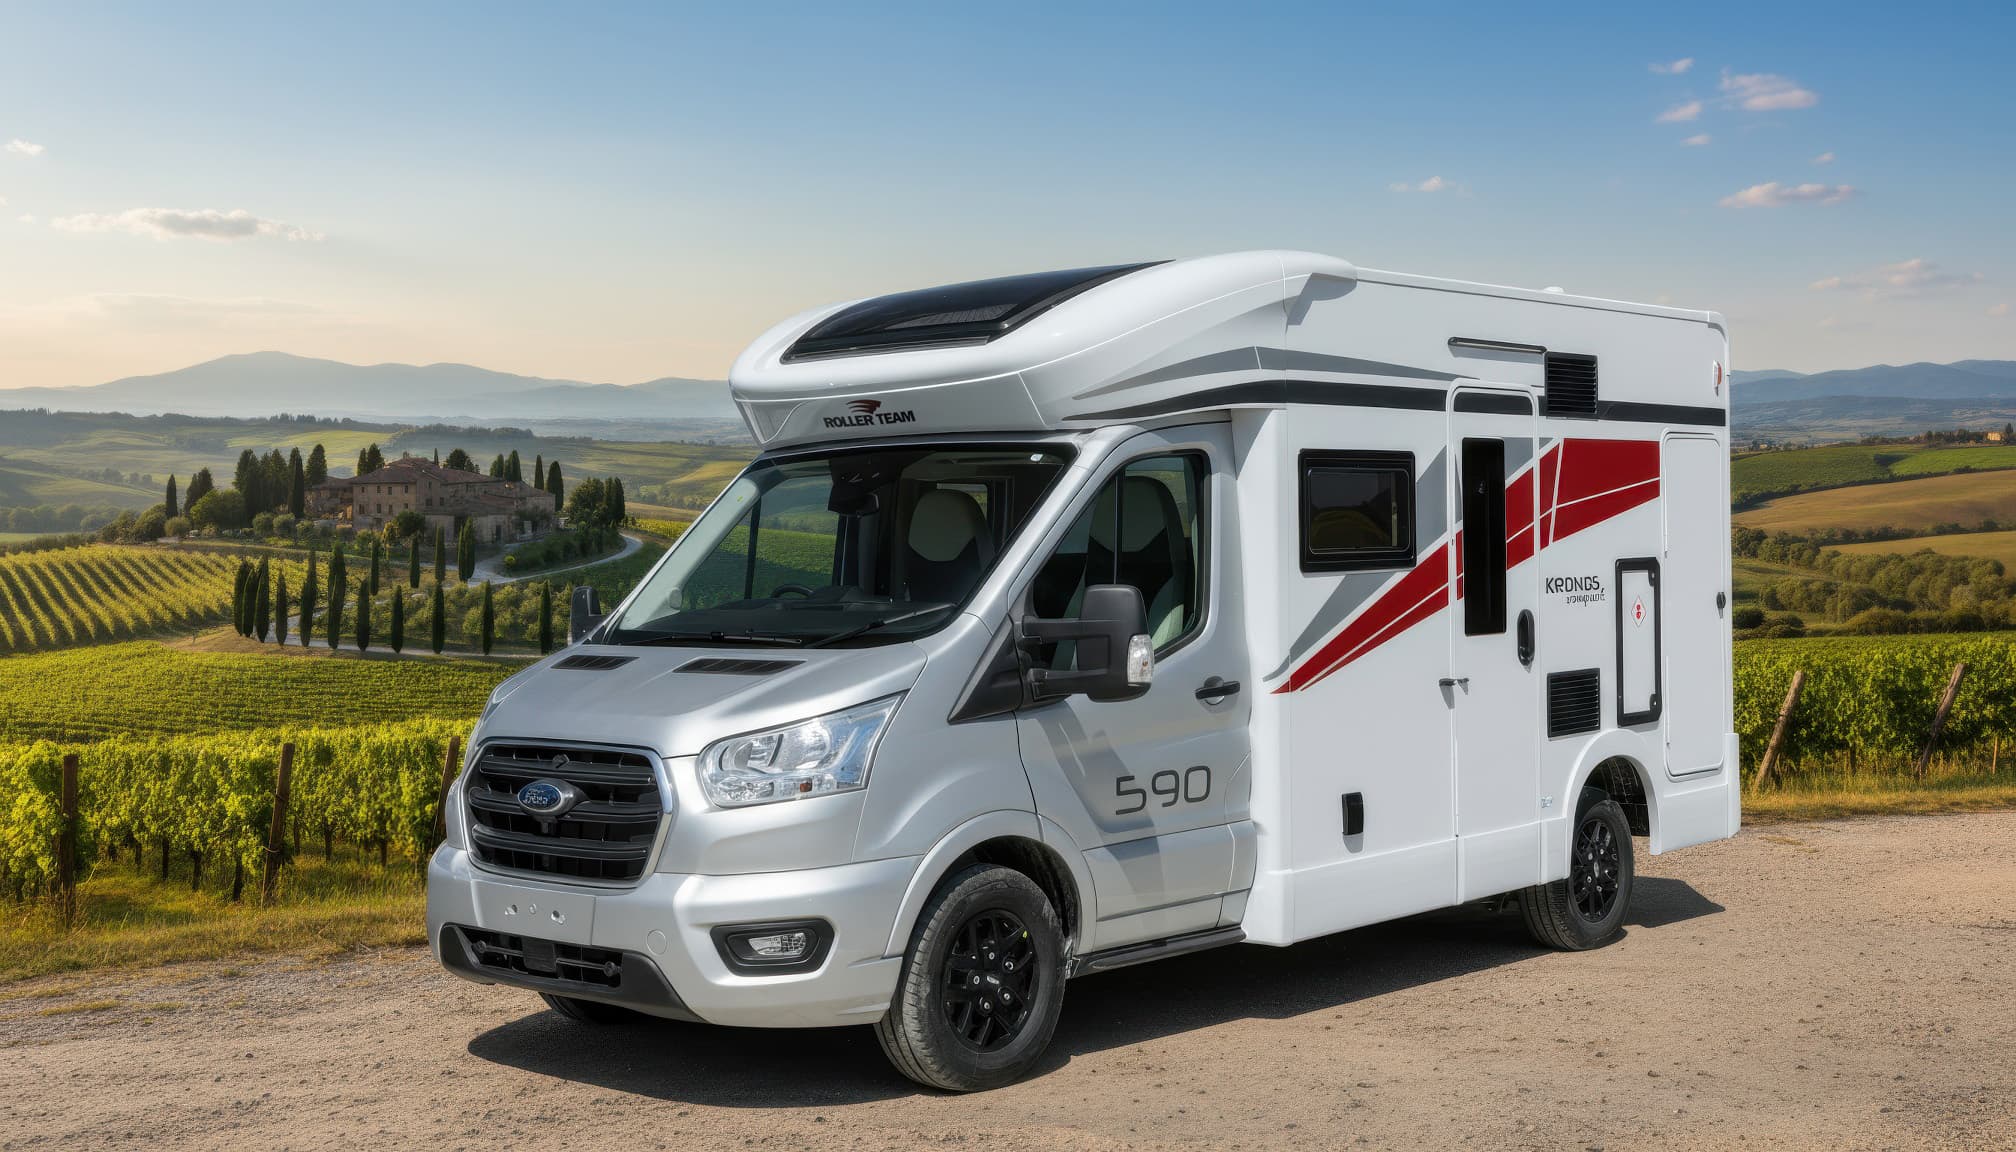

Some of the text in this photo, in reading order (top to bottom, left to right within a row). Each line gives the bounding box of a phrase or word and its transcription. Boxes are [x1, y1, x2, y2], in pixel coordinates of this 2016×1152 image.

[823, 410, 916, 428] ROLLER TEAM
[1115, 765, 1211, 815] 590
